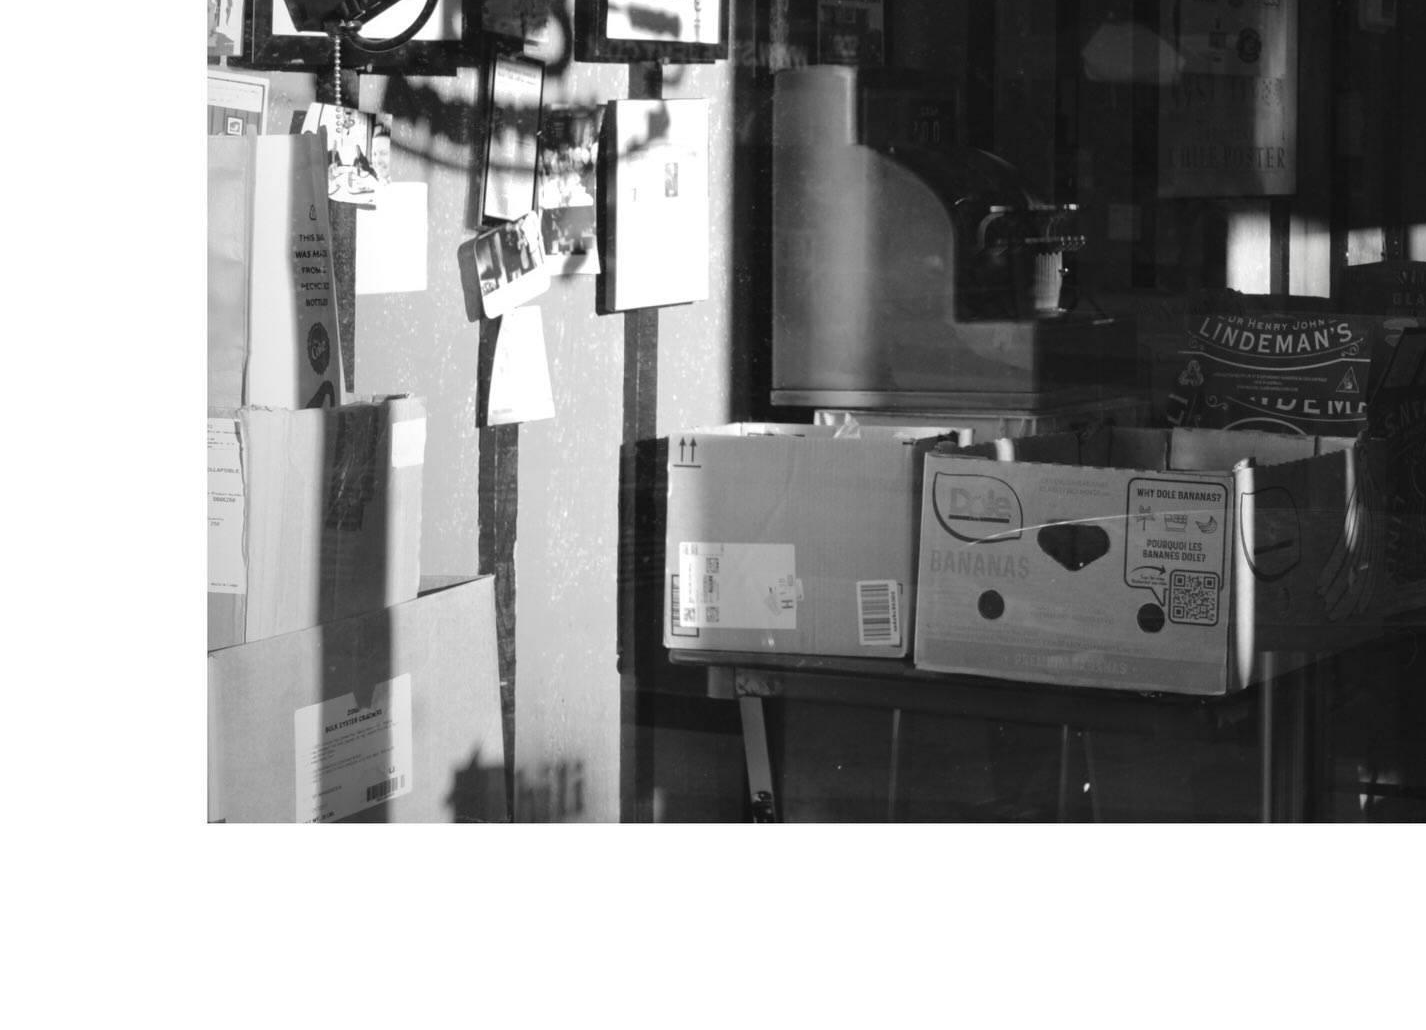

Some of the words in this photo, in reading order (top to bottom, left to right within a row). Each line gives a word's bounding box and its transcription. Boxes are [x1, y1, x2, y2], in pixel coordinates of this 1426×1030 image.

[1247, 318, 1289, 331] HENRY
[1292, 318, 1326, 331] JOHN
[1199, 316, 1354, 354] LINDEMAN'S
[948, 486, 1012, 517] Dole
[1136, 488, 1155, 499] WHY
[1156, 489, 1177, 501] DOLE
[1177, 490, 1222, 503] BANANAS?
[1146, 538, 1187, 551] POURQUOI
[1188, 542, 1203, 552] LES
[1142, 549, 1181, 561] BANANES
[1181, 552, 1207, 563] DOLE?
[929, 548, 1031, 580] BANANAS
